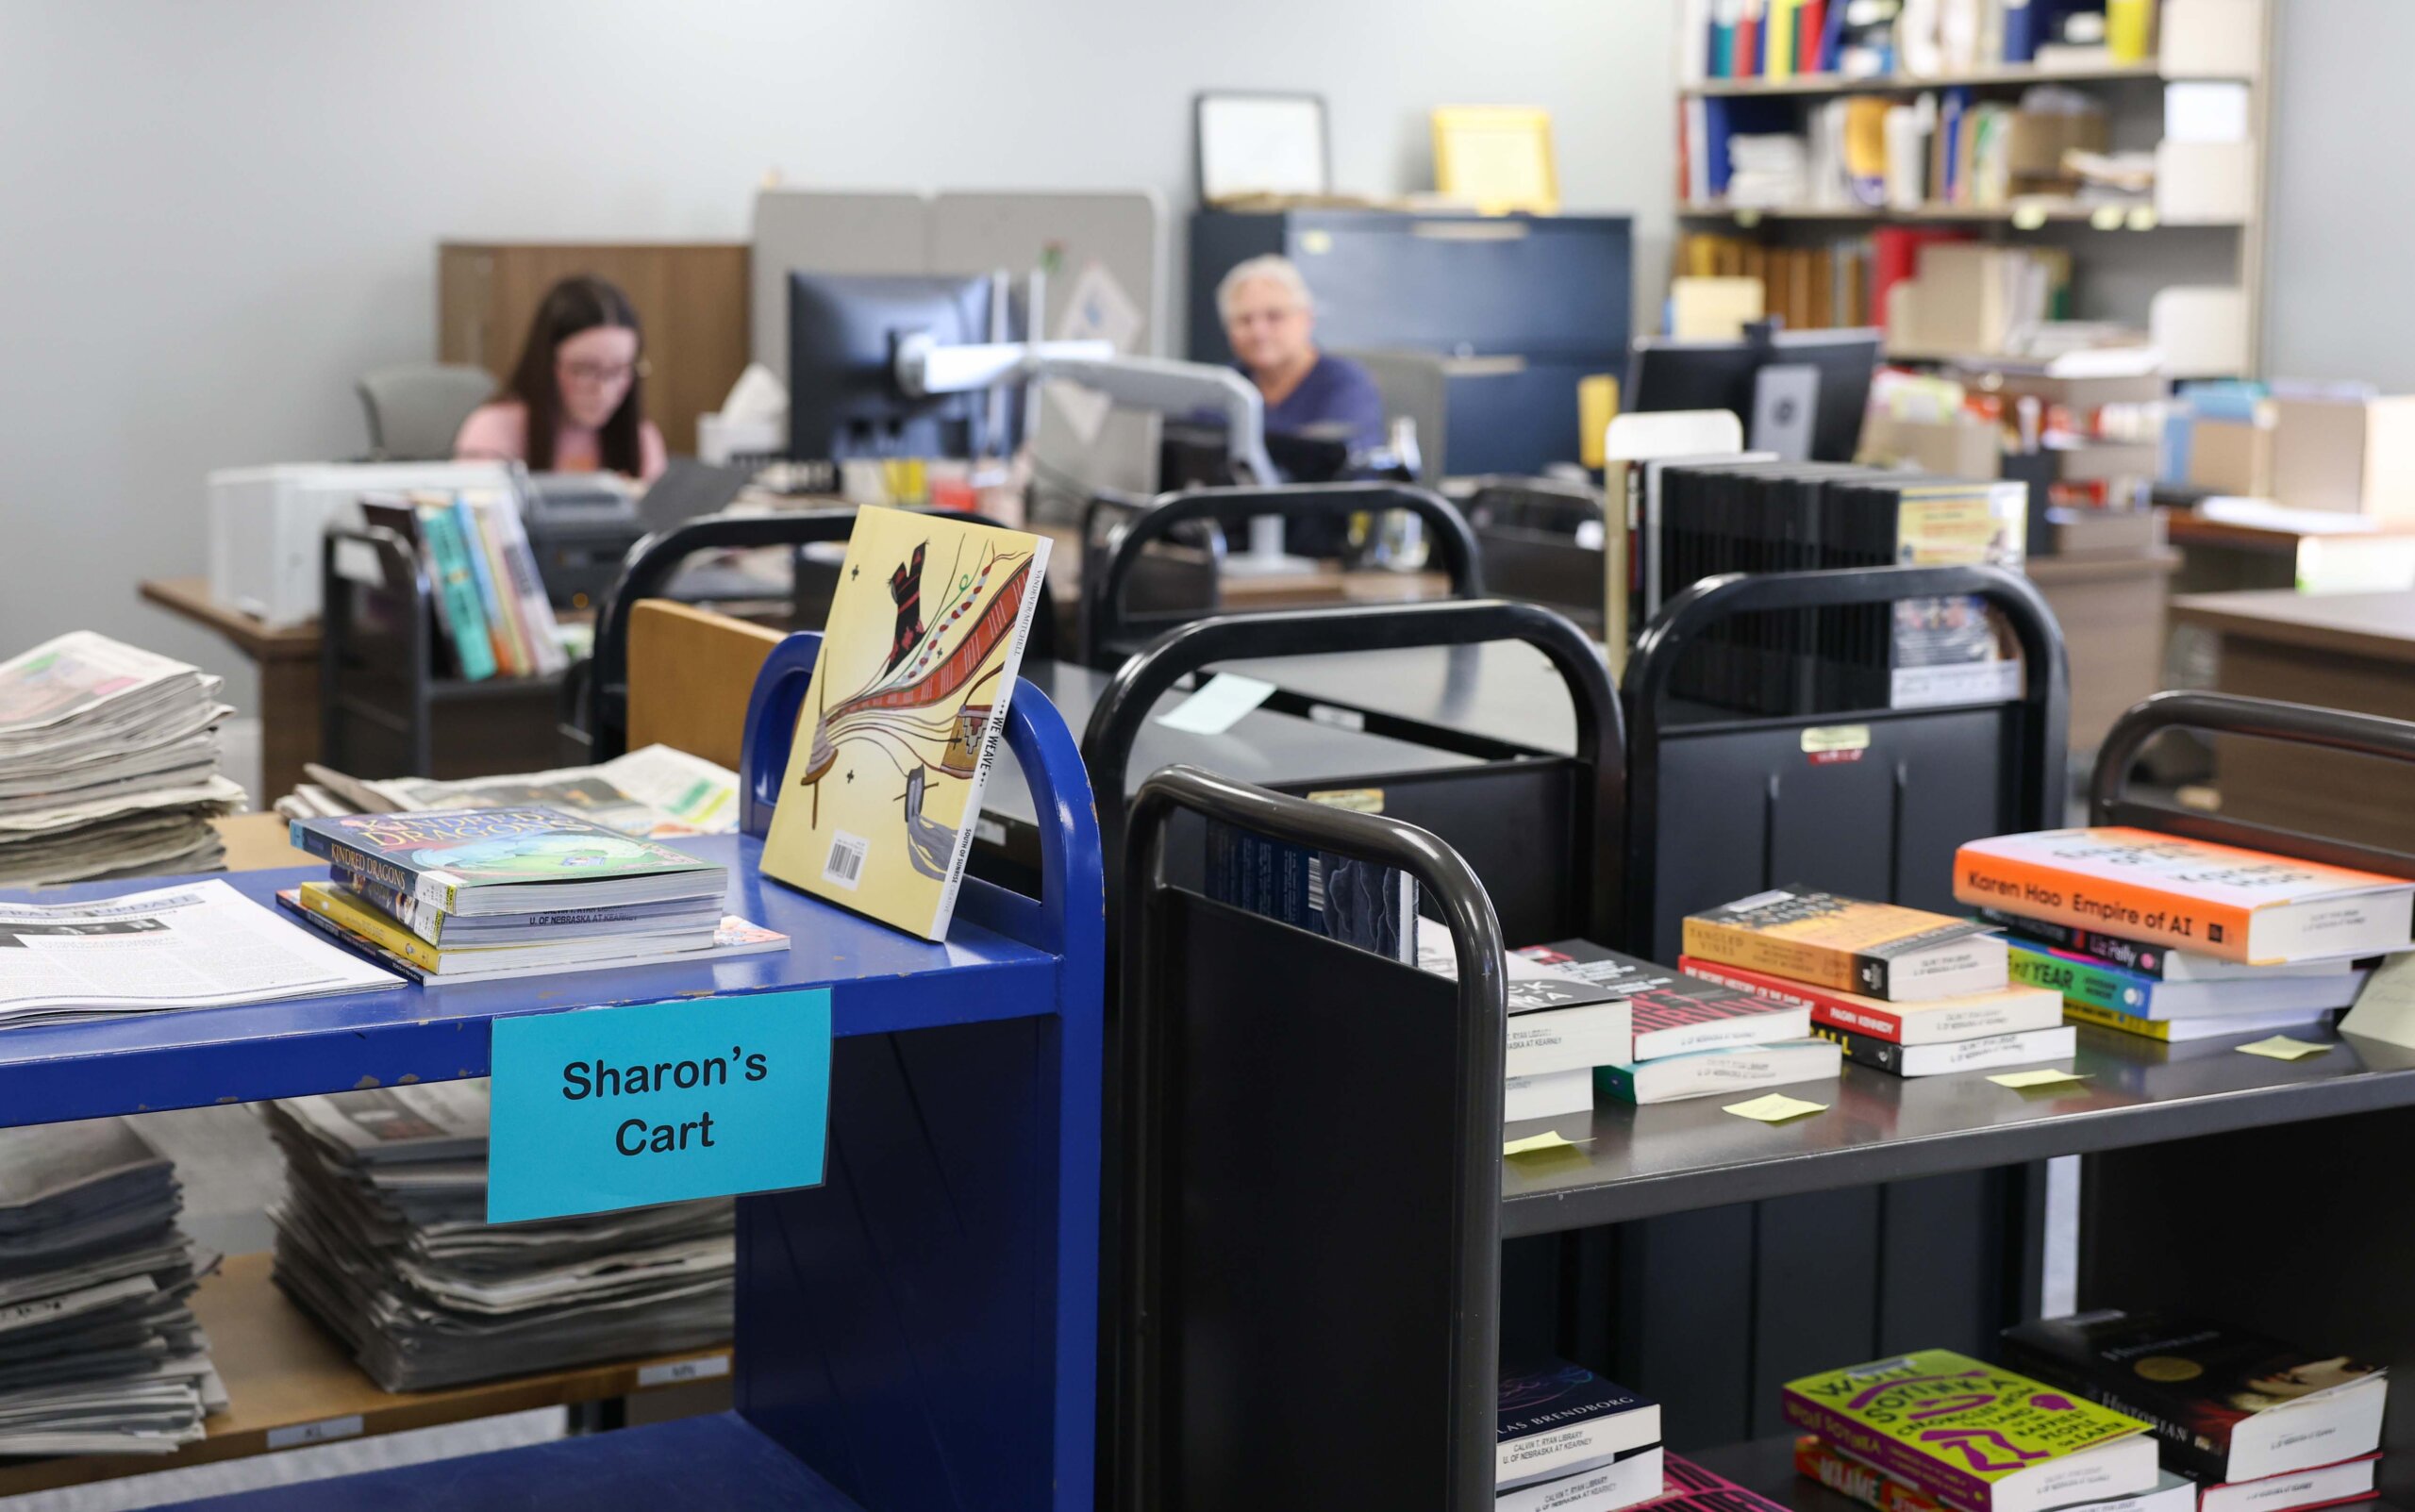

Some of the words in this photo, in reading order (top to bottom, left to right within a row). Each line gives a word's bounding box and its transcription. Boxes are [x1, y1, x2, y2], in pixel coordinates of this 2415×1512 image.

[990, 716, 1006, 733] WE
[981, 732, 1000, 772] WEAVE
[360, 820, 592, 847] DRAGONS
[962, 828, 973, 846] SOUTH
[331, 842, 366, 872] KINDRED
[366, 858, 407, 891] DRAGONS
[951, 857, 965, 884] SUNRISE
[1968, 871, 2021, 898] Karen
[2025, 886, 2062, 906] Hao
[2073, 894, 2139, 925] Empire
[2144, 909, 2167, 929] of
[2170, 916, 2193, 937] AI
[539, 916, 549, 925] OF
[550, 914, 591, 925] NEBRASKA
[591, 914, 603, 922] AT
[2089, 935, 2107, 955] Liz
[2107, 938, 2138, 970] Pelly
[1534, 1037, 1562, 1047] KEARNEY
[562, 1045, 768, 1101] Sharon's
[615, 1111, 715, 1156] Cart
[1530, 1396, 1635, 1426] BRENDBORG
[1864, 1377, 2020, 1423] SOYINKA
[1503, 1455, 1509, 1464] U.
[1510, 1453, 1520, 1463] OF
[1521, 1446, 1554, 1460] NEBRASKA
[1555, 1443, 1563, 1454] AT
[1563, 1437, 1592, 1452] KEARNEY
[1513, 1441, 1535, 1453] CALVIN
[1535, 1439, 1541, 1449] T.
[1541, 1437, 1558, 1448] RYAN
[1558, 1431, 1584, 1444] LIBRARY
[1570, 1484, 1585, 1495] RYAN
[1582, 1490, 1591, 1499] AT
